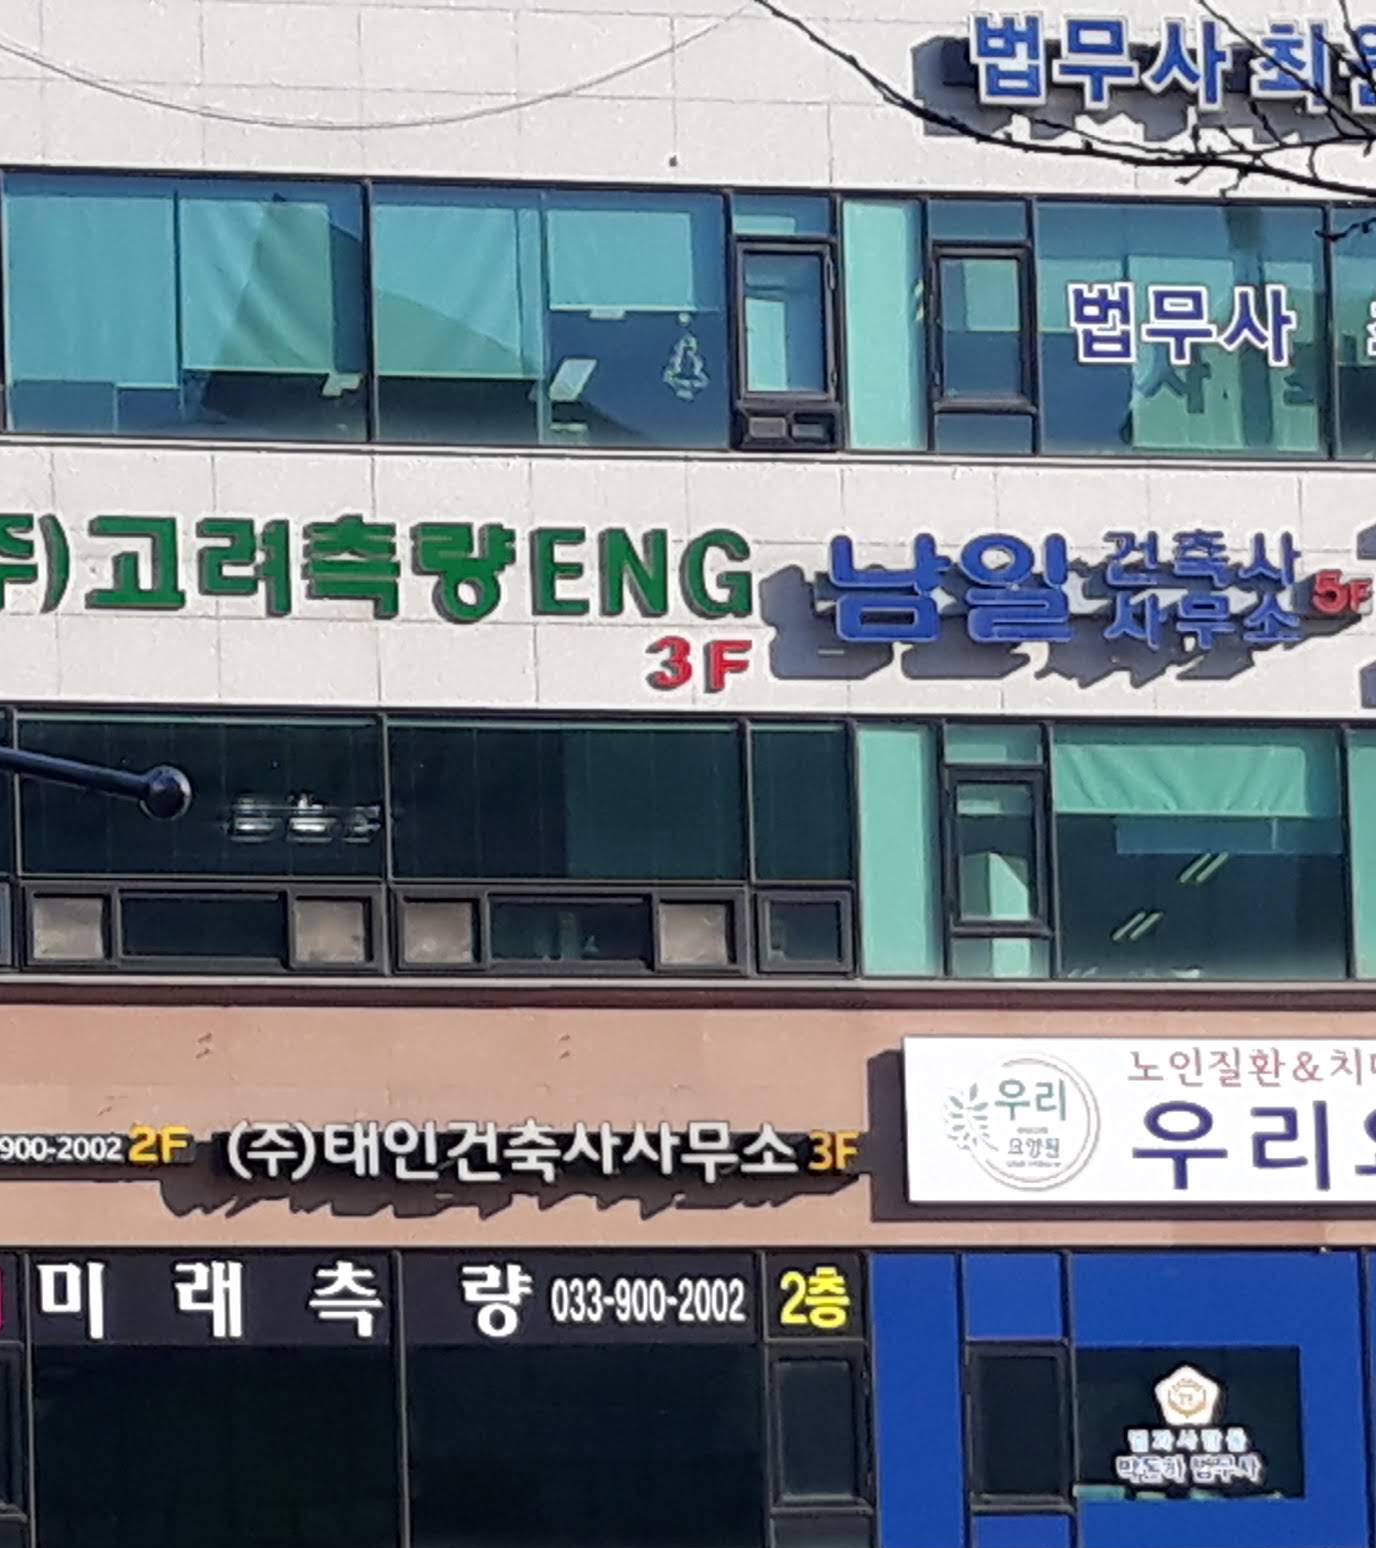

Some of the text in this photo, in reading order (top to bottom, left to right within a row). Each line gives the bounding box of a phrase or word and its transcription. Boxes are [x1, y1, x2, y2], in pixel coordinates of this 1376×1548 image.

[969, 12, 1224, 109] 법무사
[1070, 283, 1297, 366] 법무사
[828, 532, 1071, 644] 남일
[1102, 528, 1301, 587] 건축사
[1101, 589, 1303, 650] 사무소
[1312, 570, 1374, 614] 5F
[646, 635, 754, 692] 3F
[993, 1077, 1067, 1122] 우리
[128, 1125, 188, 1163] 2F
[227, 1118, 860, 1184] (주)태인건축사사무소 3F
[550, 1277, 746, 1324] 033-900-2002
[779, 1265, 852, 1329] 2층
